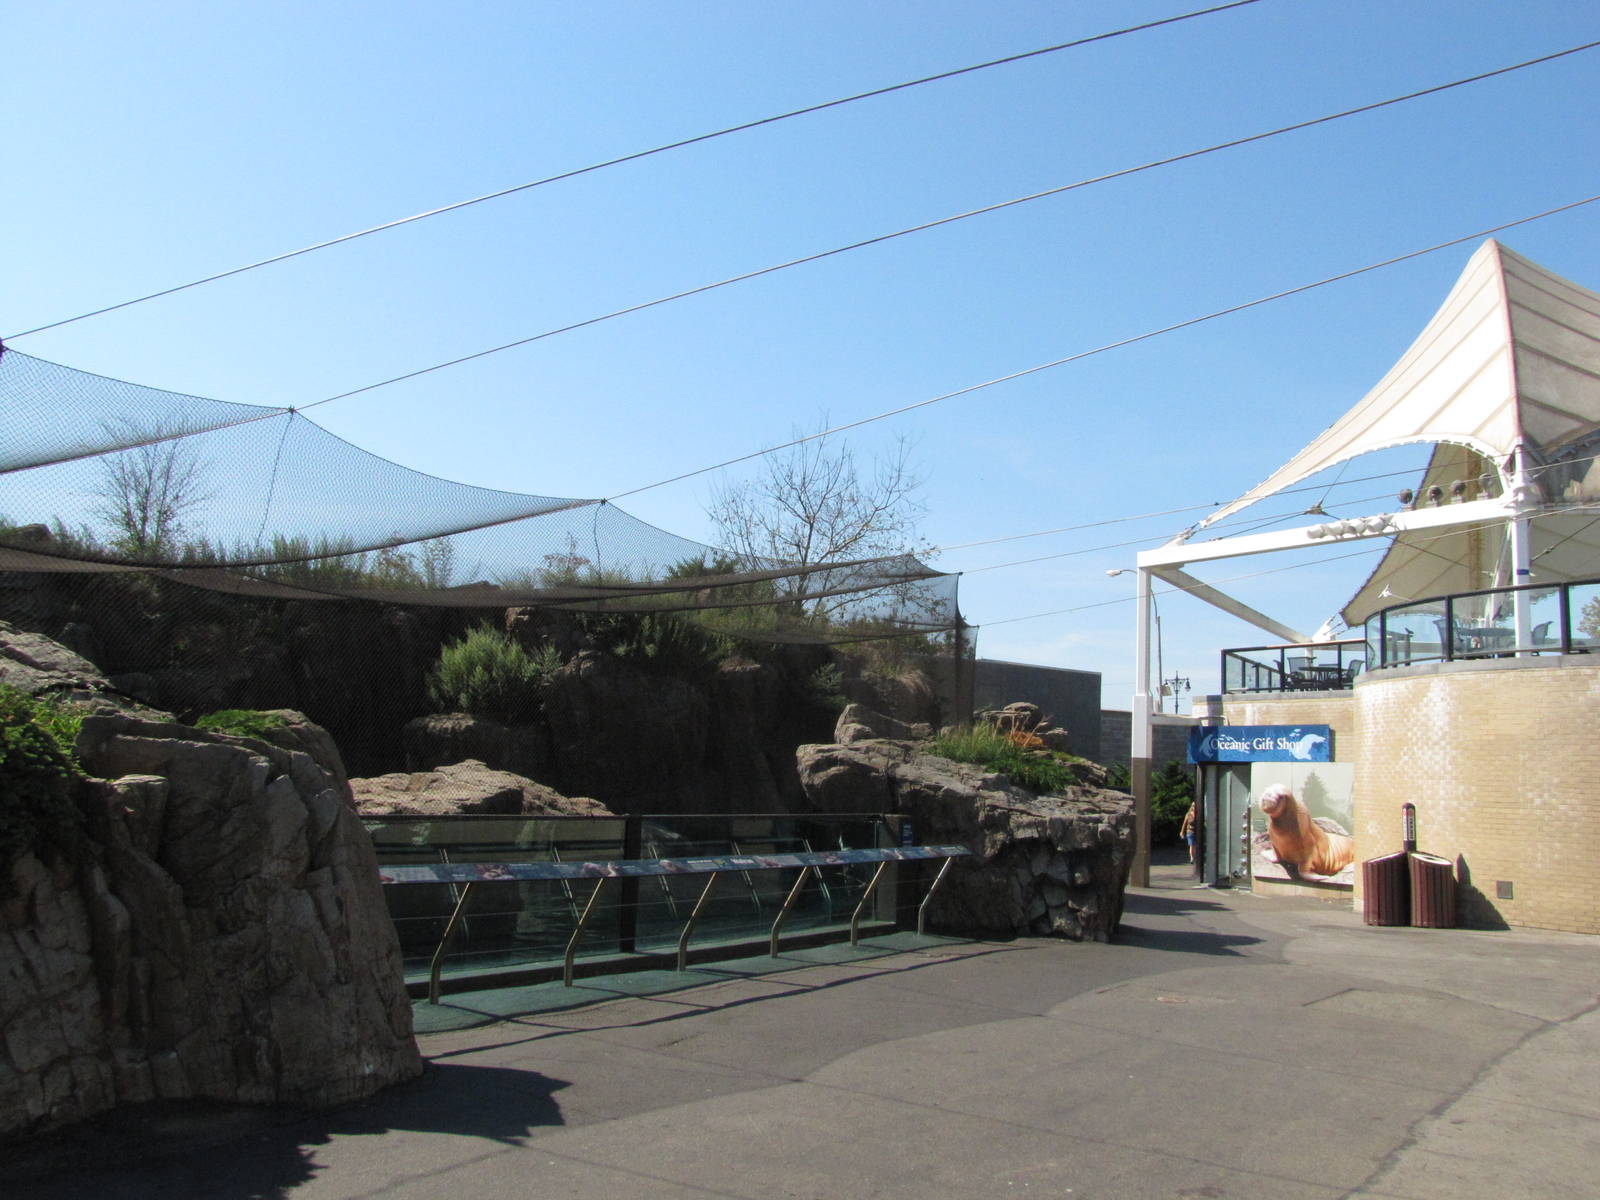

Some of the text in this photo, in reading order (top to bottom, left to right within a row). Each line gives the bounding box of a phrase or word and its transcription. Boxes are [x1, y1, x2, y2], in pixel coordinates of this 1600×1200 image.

[1210, 737, 1303, 753] Oceanic Gift Shop
